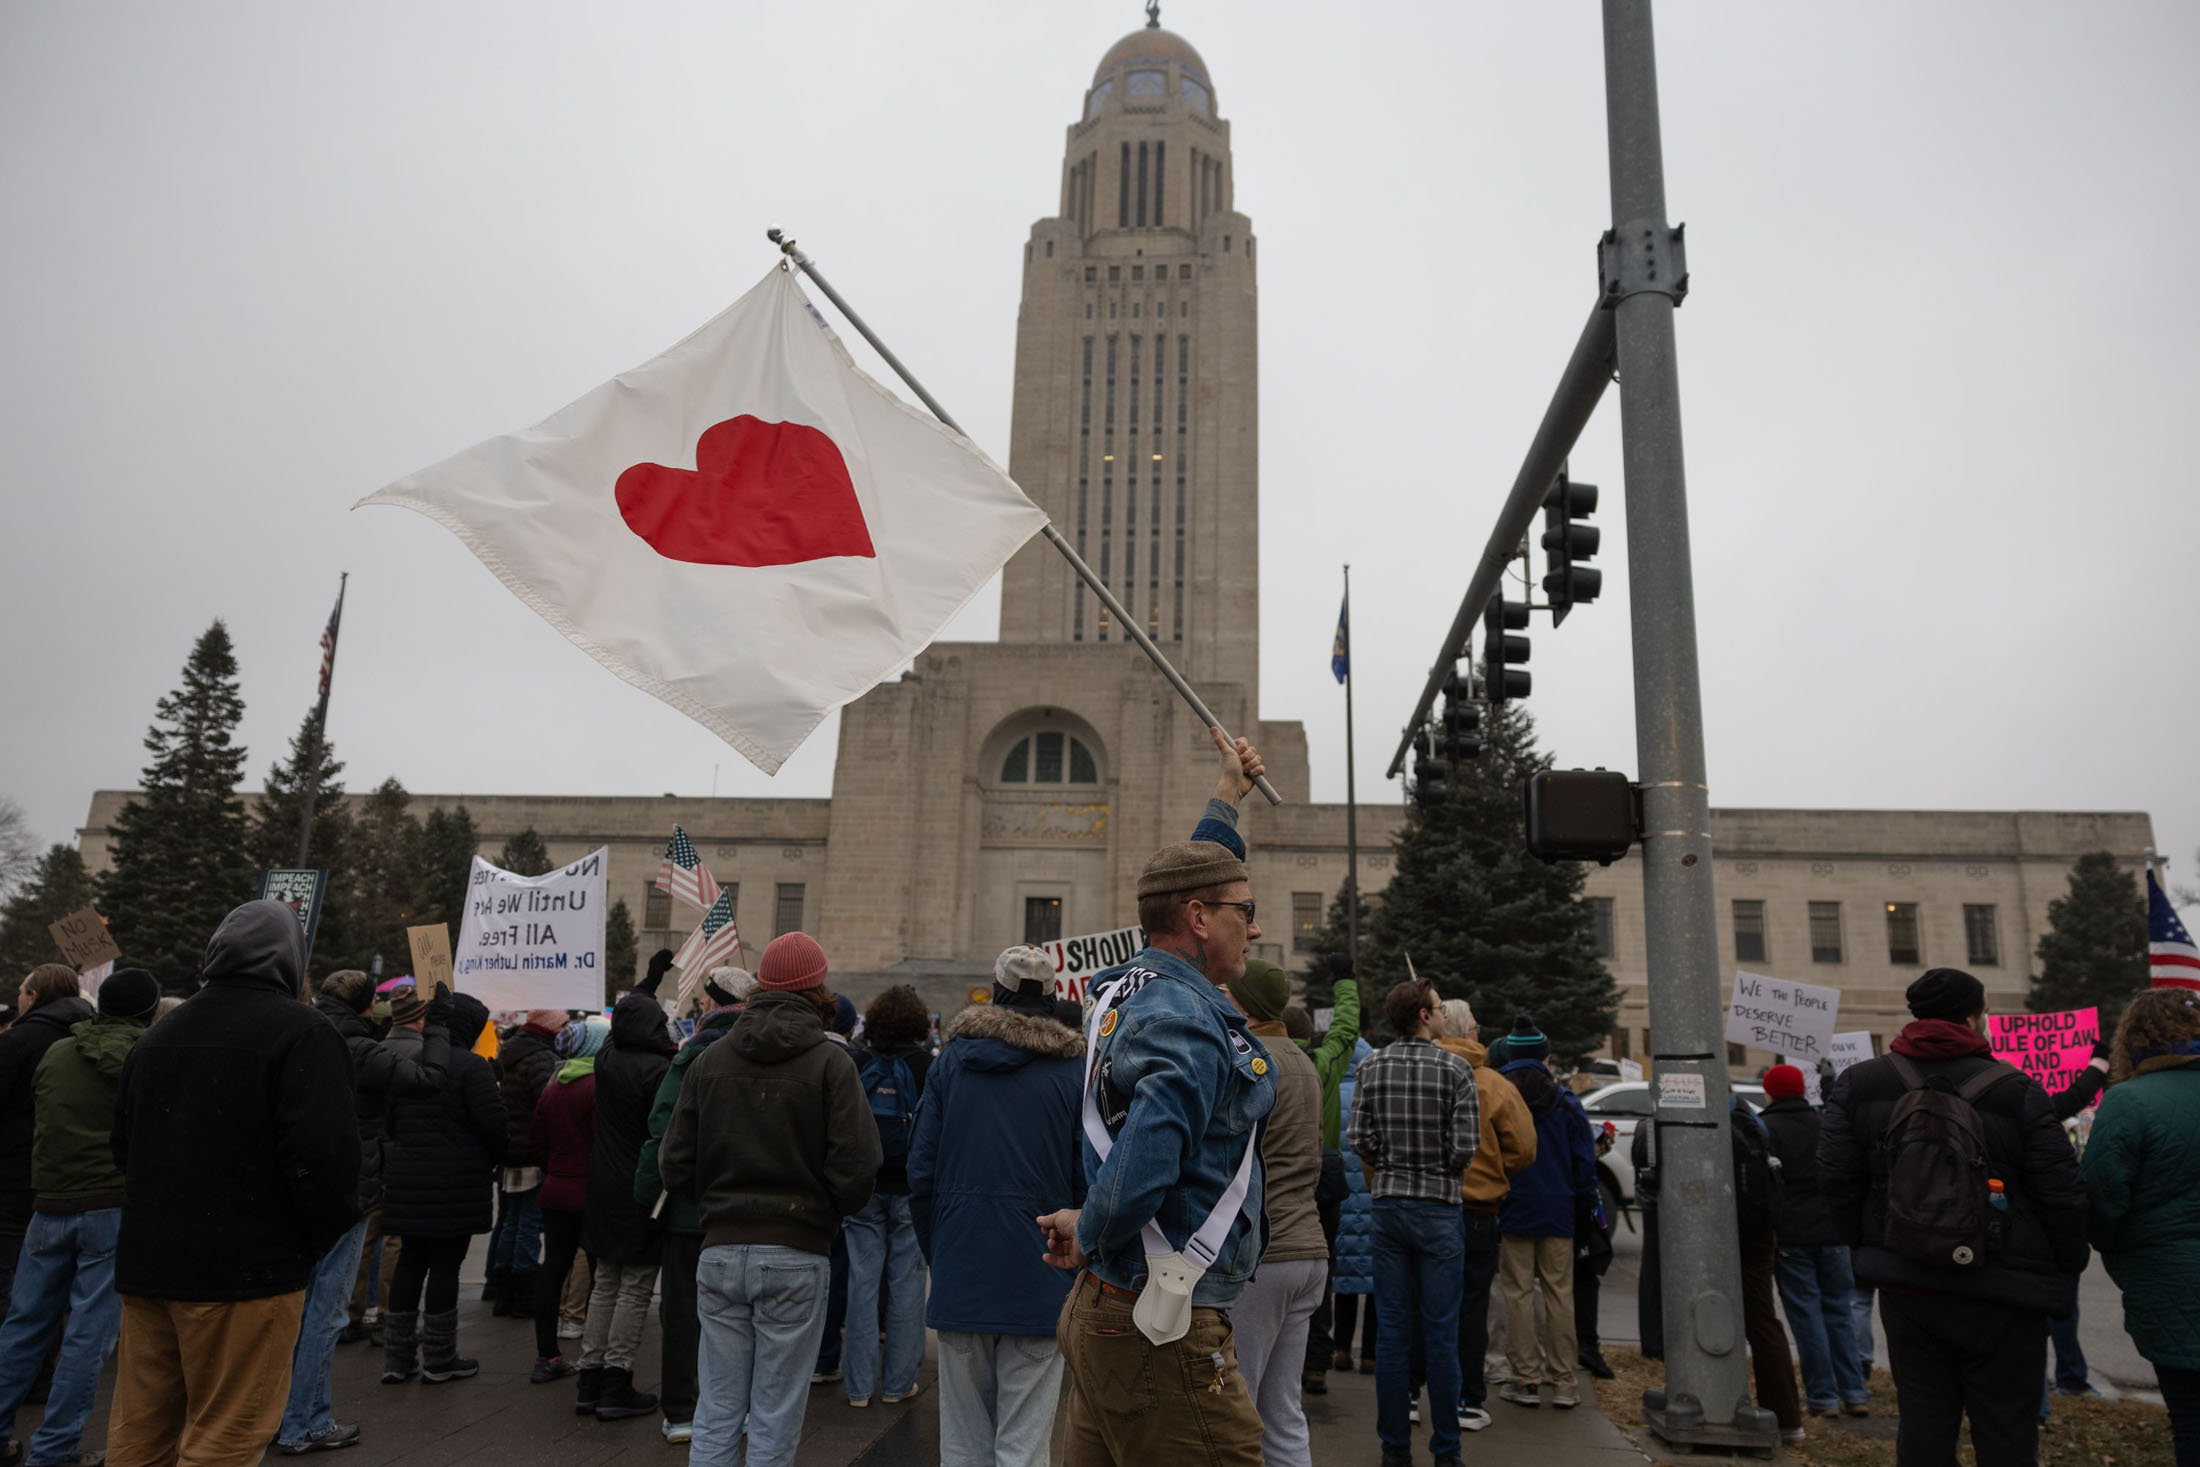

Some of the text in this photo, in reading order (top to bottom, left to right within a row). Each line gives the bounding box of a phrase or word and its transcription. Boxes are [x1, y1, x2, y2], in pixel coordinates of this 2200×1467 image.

[268, 882, 313, 892] IMPEACH
[270, 873, 315, 882] IMPEACH
[61, 919, 88, 938] NO
[64, 931, 113, 965] MUSK
[1066, 926, 1147, 973] SHOUL
[1740, 978, 1762, 998] WE
[1795, 988, 1829, 1012] PEOPLE
[1733, 1004, 1795, 1029] DESERVE
[2000, 1013, 2077, 1033] UPHOLD
[1752, 1026, 1820, 1054] BETTER
[1832, 1041, 1857, 1052] OU'VE
[1991, 1027, 2097, 1053] ULE OF LAW
[2021, 1052, 2062, 1071] AND
